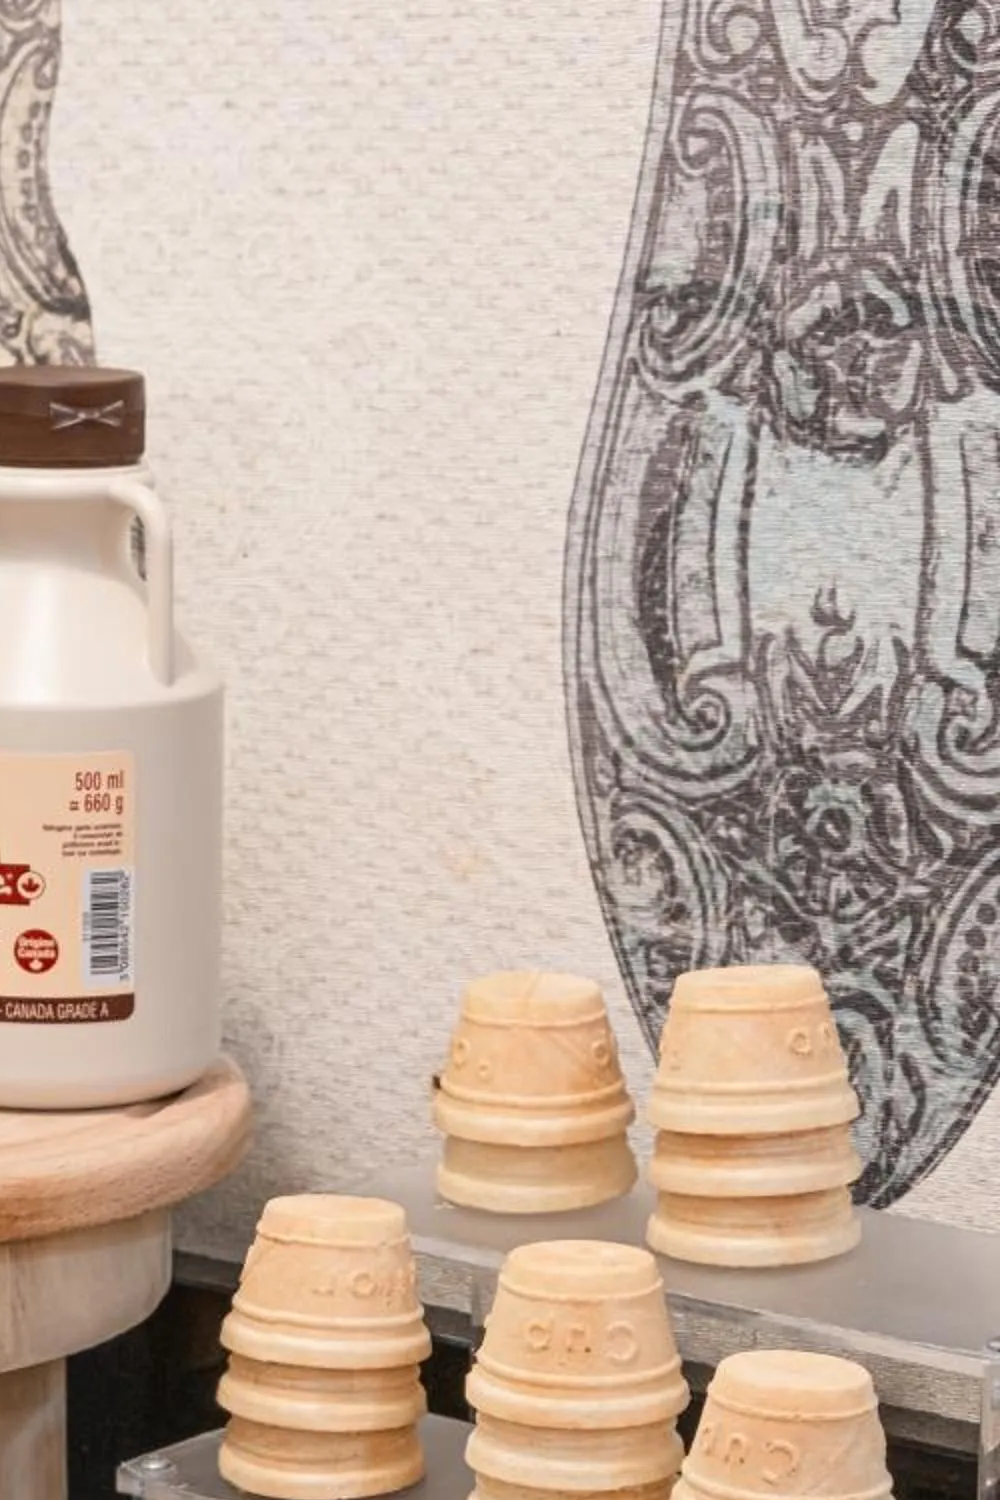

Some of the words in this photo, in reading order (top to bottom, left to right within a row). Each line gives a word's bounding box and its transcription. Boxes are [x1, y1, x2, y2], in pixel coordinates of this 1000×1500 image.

[75, 771, 101, 791] 500
[107, 770, 124, 789] ml
[84, 793, 111, 812] 660
[115, 795, 124, 815] g
[5, 1002, 52, 1020] CANADA
[56, 1003, 98, 1020] GRADE
[100, 1002, 109, 1018] A
